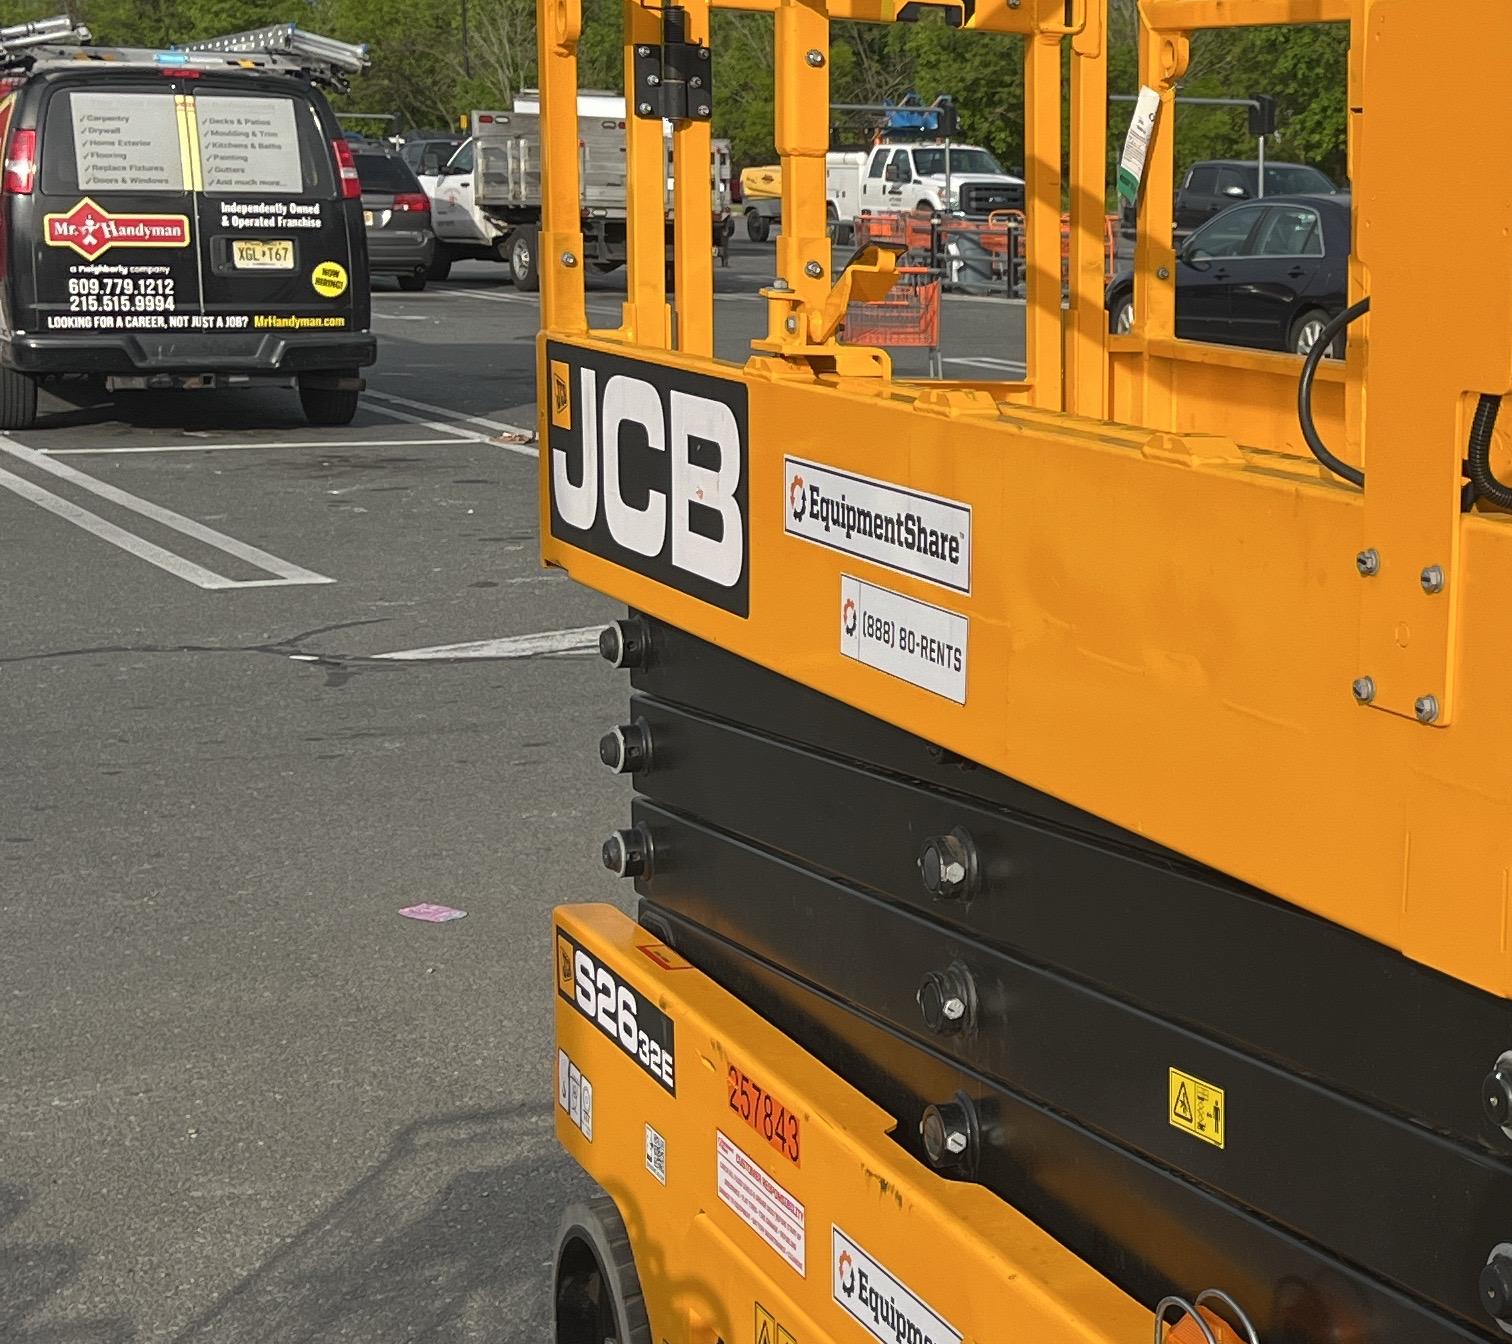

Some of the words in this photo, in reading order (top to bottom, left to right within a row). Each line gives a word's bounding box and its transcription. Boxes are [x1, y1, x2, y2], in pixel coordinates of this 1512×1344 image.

[221, 202, 287, 215] Independently
[289, 203, 320, 215] Owned
[54, 221, 78, 236] Mr.
[100, 220, 182, 240] Handyman
[221, 215, 230, 227] &
[232, 216, 275, 229] Operated
[278, 216, 322, 228] Franchise
[68, 278, 175, 295] 609.779.1212
[69, 296, 175, 311] 215.515.9994
[47, 316, 93, 328] LOOKING
[93, 316, 114, 328] FOR
[115, 316, 124, 328] A
[125, 316, 168, 329] CAREER,
[169, 316, 190, 328] NOT
[191, 316, 215, 328] JUST
[216, 316, 223, 328] A
[225, 316, 249, 328] JOB?
[254, 315, 345, 329] MrHandyman.com
[552, 366, 743, 588] JCB
[808, 484, 961, 565] EquipmentShare
[862, 610, 896, 647] (888)
[899, 626, 963, 673] 80-RENTS
[574, 949, 639, 1055] S26
[637, 1029, 675, 1089] 32E
[728, 1064, 800, 1163] 257843
